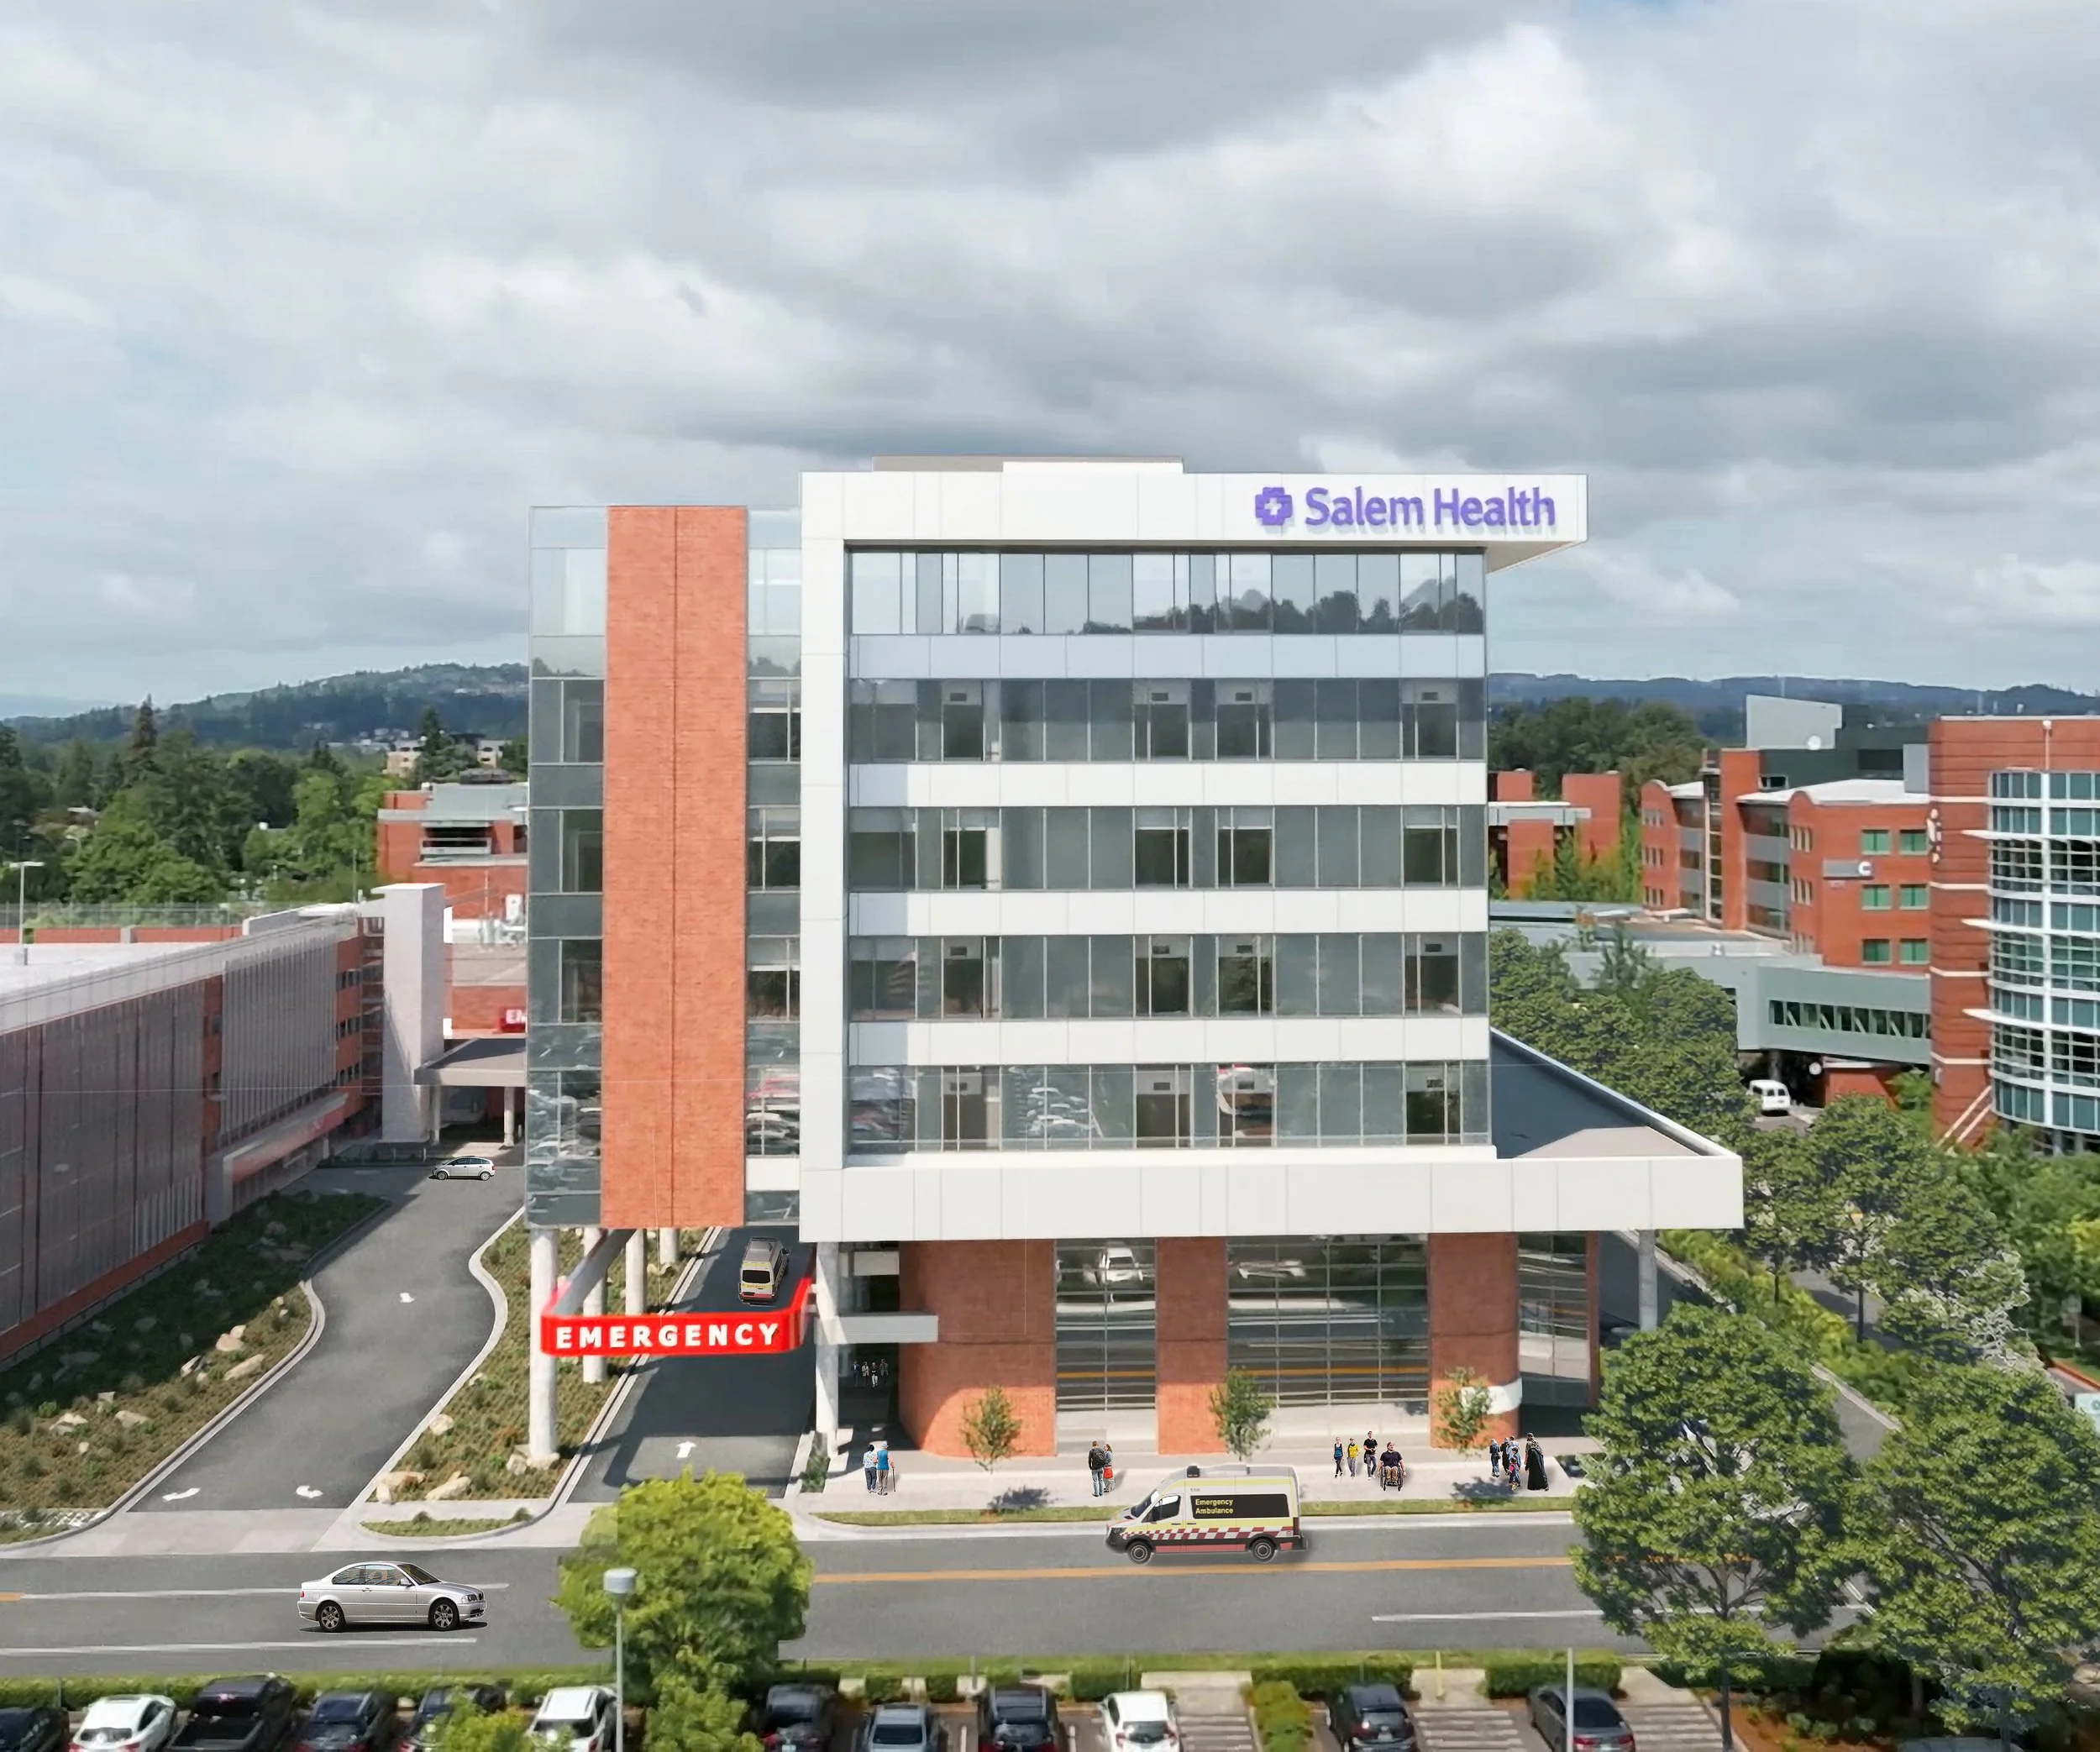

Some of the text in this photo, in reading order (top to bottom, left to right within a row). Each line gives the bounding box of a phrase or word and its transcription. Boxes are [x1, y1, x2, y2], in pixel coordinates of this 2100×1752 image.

[1305, 486, 1555, 527] Salem Health
[556, 1323, 778, 1349] EMERGENCY
[1195, 1498, 1234, 1507] Emergency
